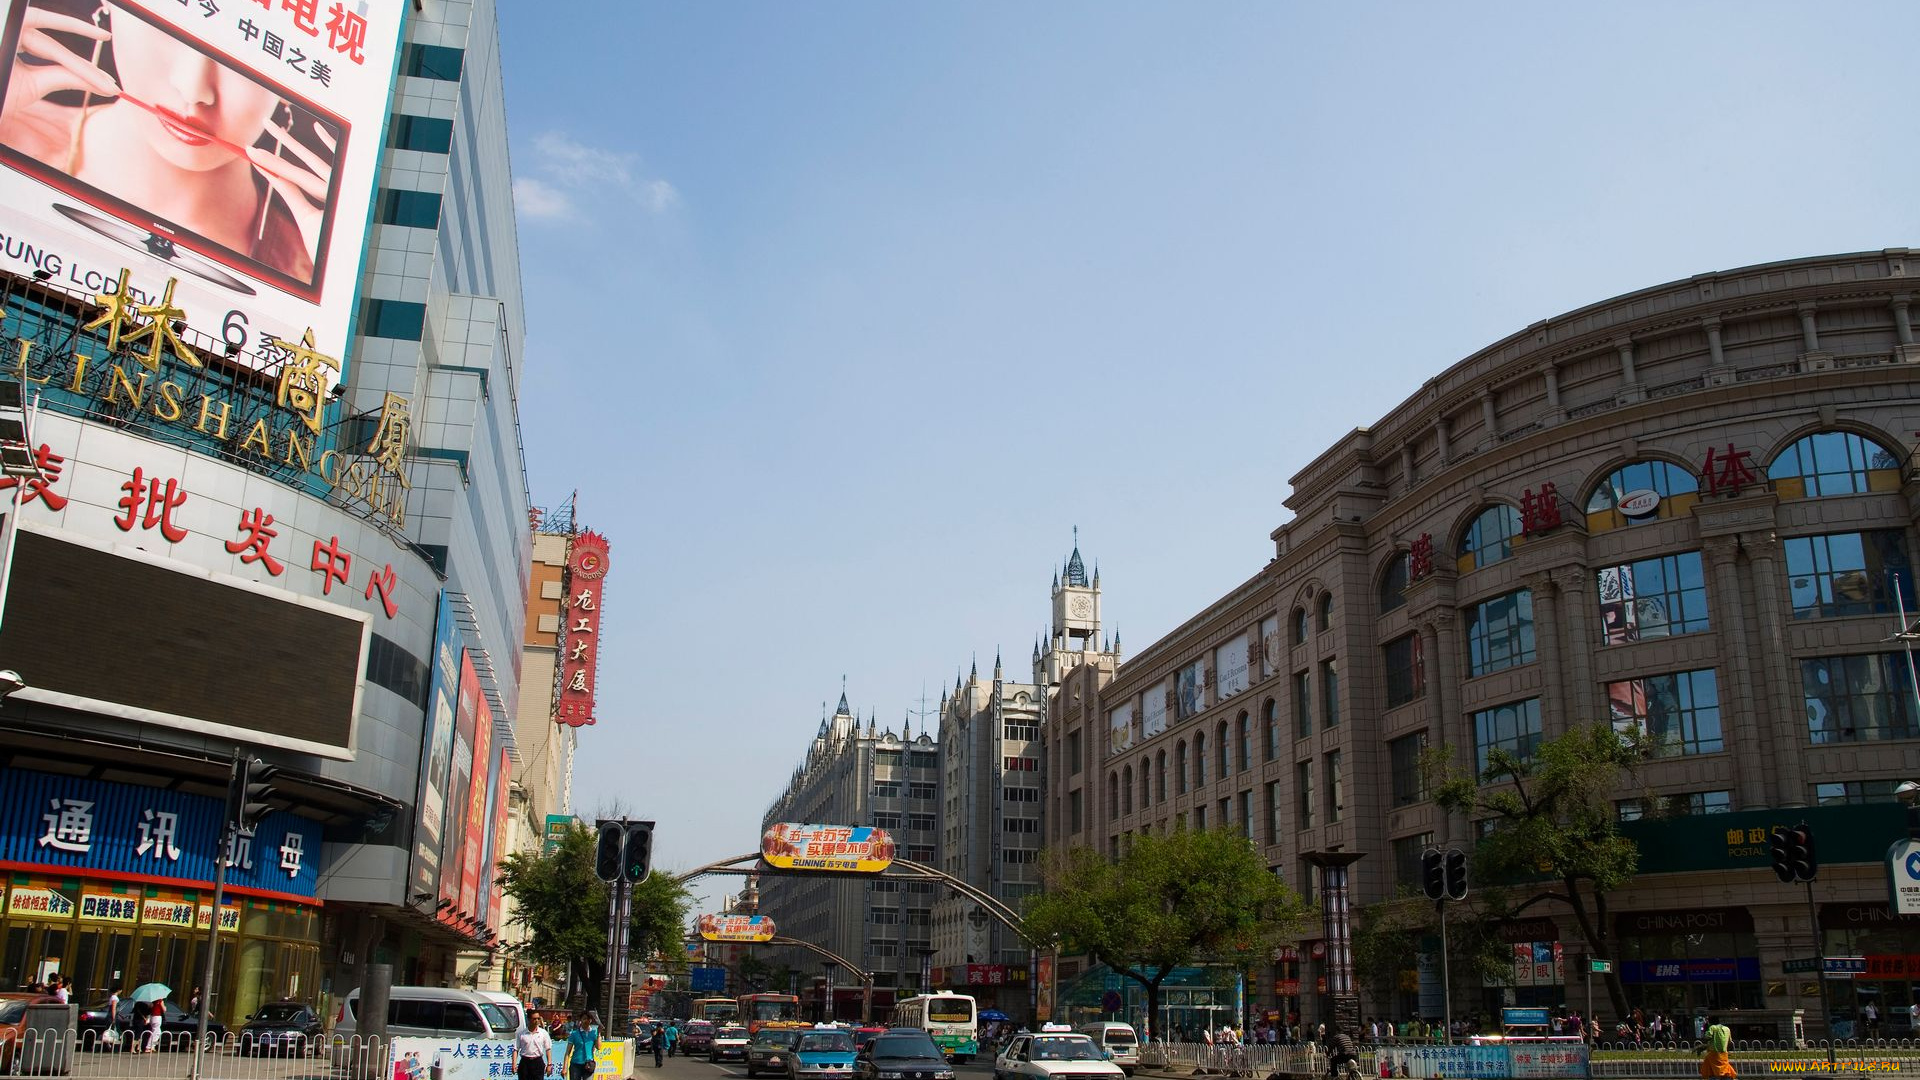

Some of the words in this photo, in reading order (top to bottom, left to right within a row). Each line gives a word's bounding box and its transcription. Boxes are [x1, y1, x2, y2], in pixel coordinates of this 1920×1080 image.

[238, 18, 333, 88] 中国之美
[0, 233, 62, 276] UNG
[70, 263, 119, 295] LCD
[38, 798, 304, 878] 通讯航母
[1727, 825, 1785, 845] 邮政
[1728, 847, 1766, 858] POSTAL
[792, 859, 827, 867] SUNING
[83, 897, 137, 920] 四楼快餐
[1637, 915, 1684, 930] CHINA
[1687, 913, 1726, 928] POST
[970, 971, 1002, 983] 宾馆
[1656, 964, 1681, 976] EMS
